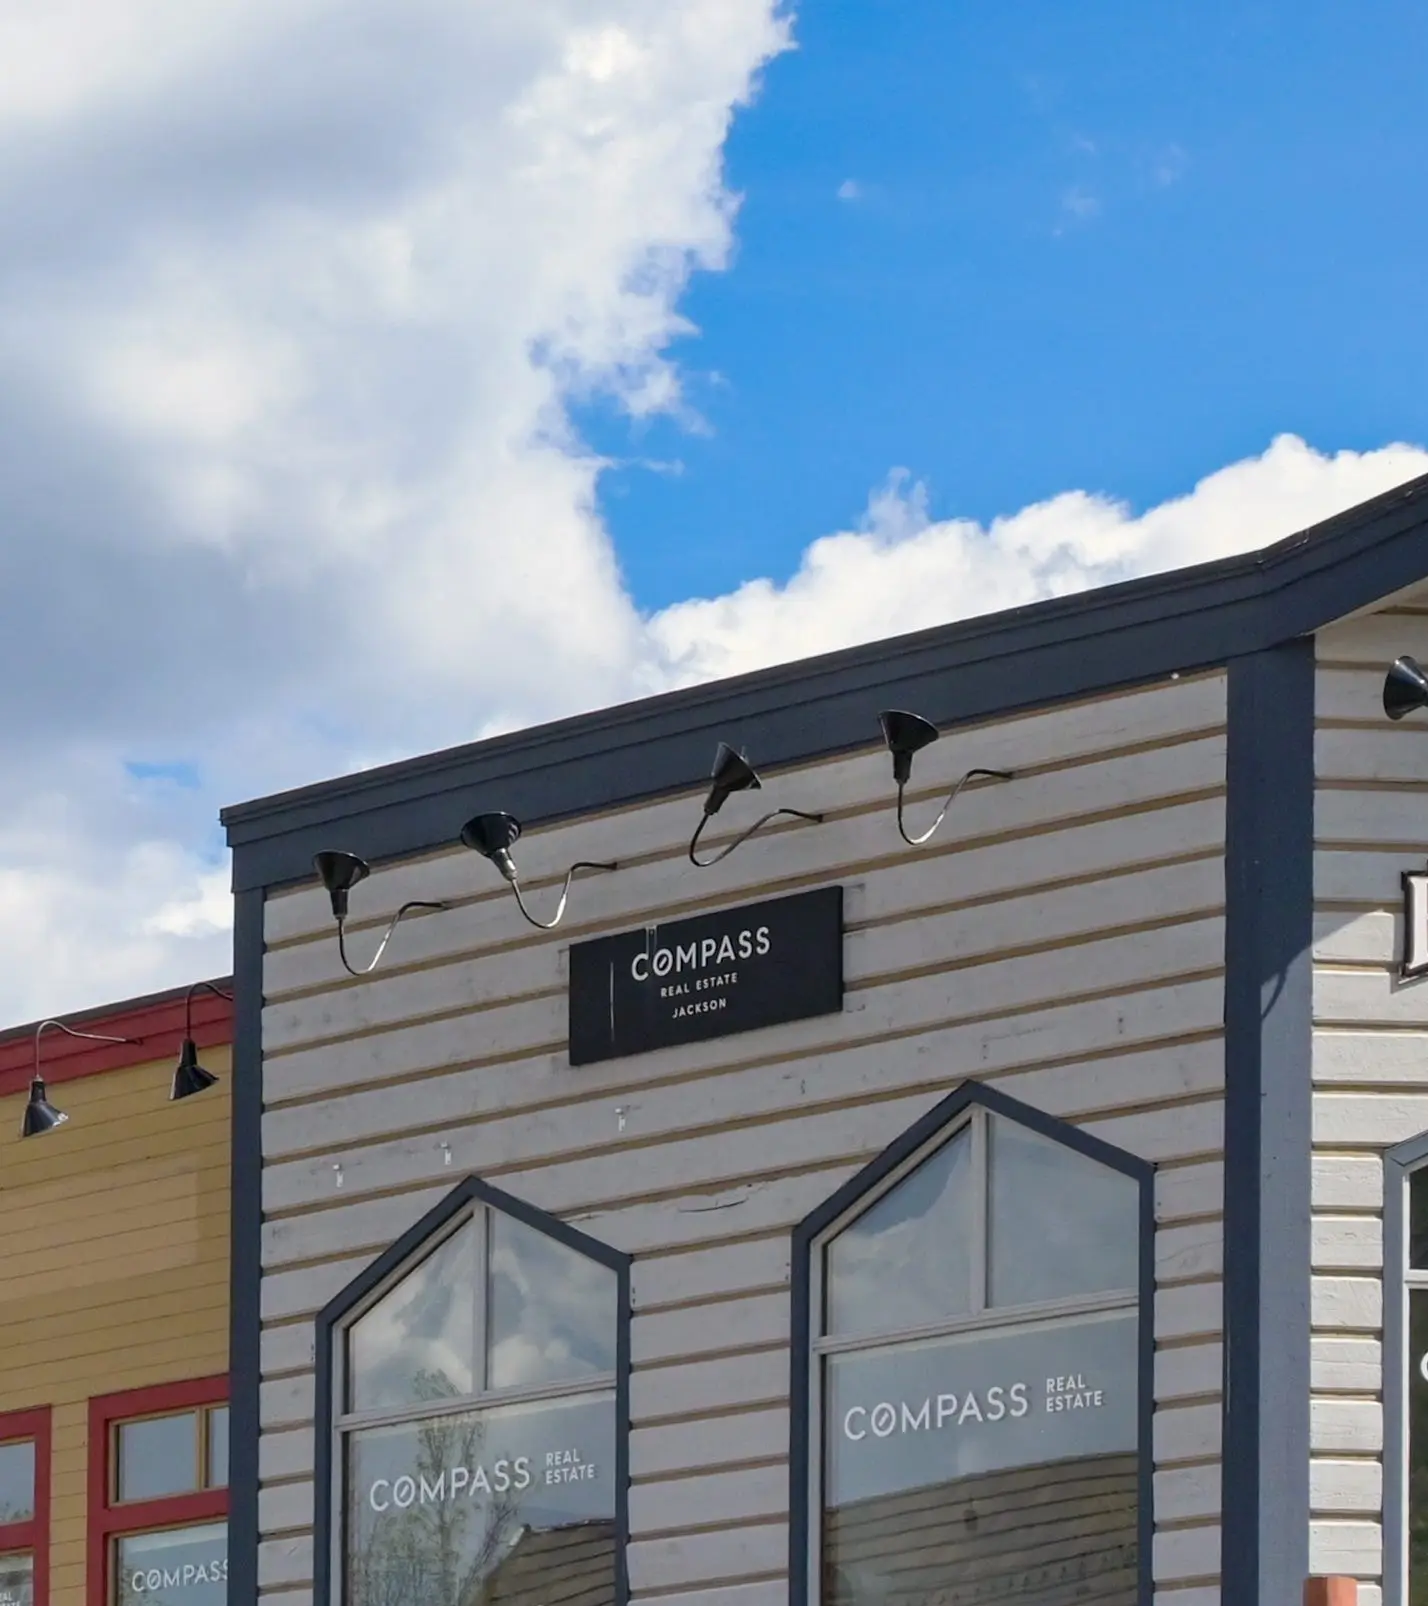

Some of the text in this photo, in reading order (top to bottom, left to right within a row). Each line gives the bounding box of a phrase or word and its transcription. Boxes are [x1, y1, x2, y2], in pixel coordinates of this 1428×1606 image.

[631, 926, 771, 982] COMPASS
[660, 972, 738, 998] REAL ESTATE
[672, 998, 727, 1019] JACKSON
[1046, 1374, 1085, 1393] REAL
[844, 1382, 1029, 1441] COMPASS
[1046, 1390, 1102, 1412] ESTATE
[546, 1449, 580, 1467] REAL
[369, 1457, 531, 1511] COMPASS
[545, 1464, 594, 1485] ESTATE
